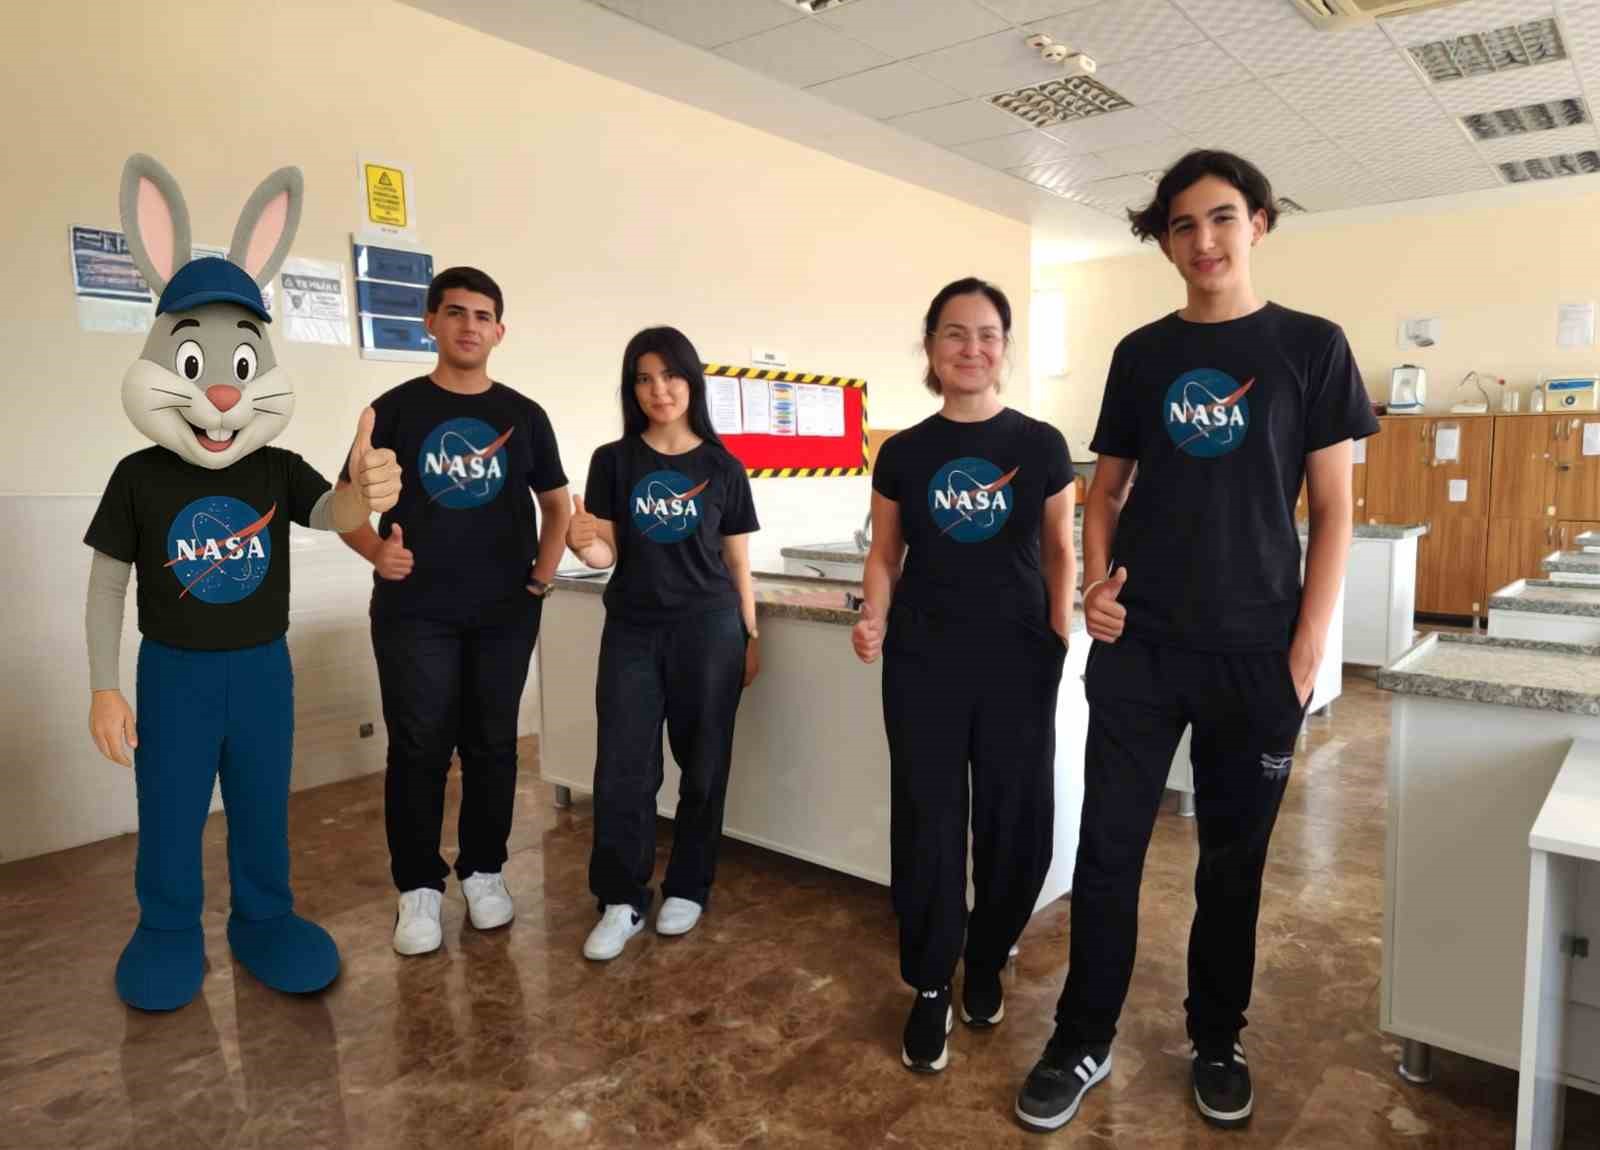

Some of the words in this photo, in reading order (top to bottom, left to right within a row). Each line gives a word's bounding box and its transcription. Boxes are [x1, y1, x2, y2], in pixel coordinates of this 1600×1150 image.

[1170, 402, 1245, 426] NASA
[424, 452, 502, 479] NASA
[635, 497, 697, 516] NASA
[934, 490, 1008, 510] NASA
[176, 536, 265, 560] NASA
